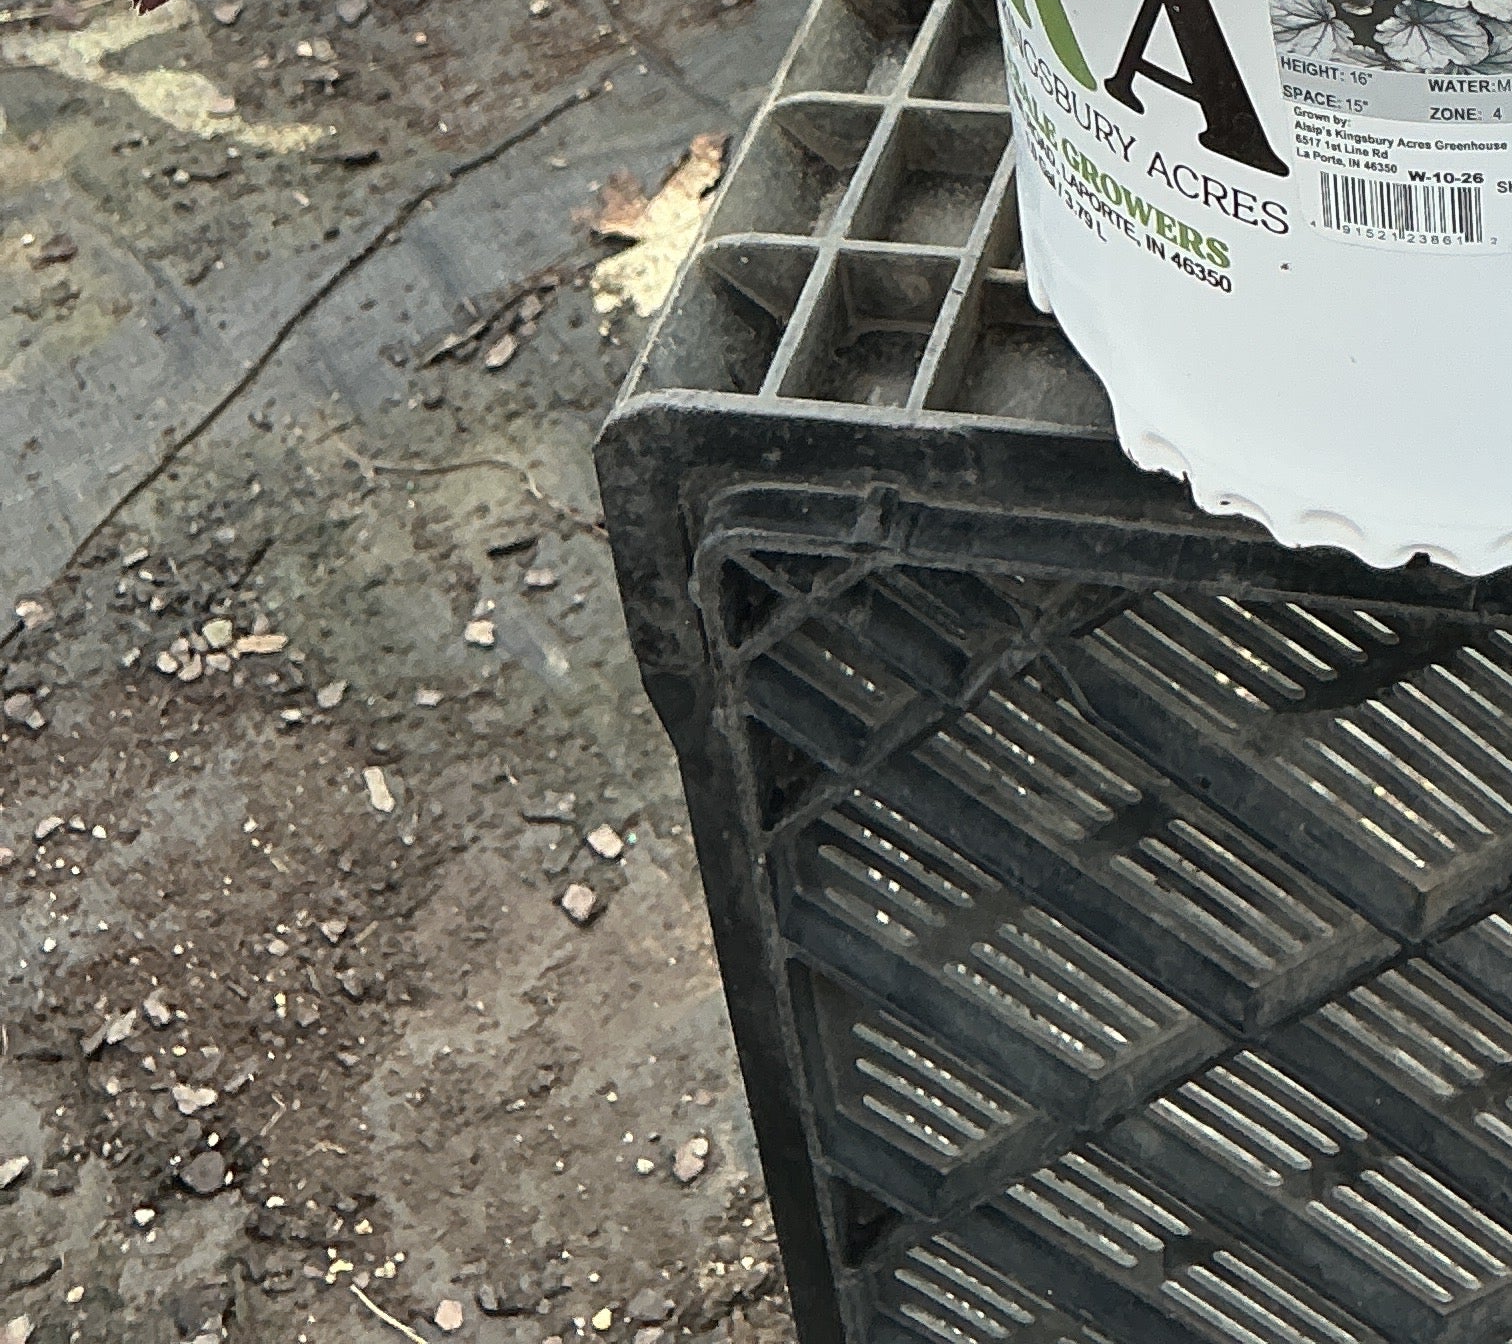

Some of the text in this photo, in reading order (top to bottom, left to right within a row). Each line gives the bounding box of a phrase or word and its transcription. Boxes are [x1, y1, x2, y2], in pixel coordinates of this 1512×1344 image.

[1280, 56, 1373, 87] HEIGHT: 16"
[1282, 84, 1369, 114] SPACE: 15"
[1293, 106, 1351, 129] Grown by:
[1430, 108, 1502, 121] ZONE: 4
[1294, 120, 1508, 151] Alsip's Kingsbury Acres Greenhouse
[1295, 134, 1389, 160] 6517 1st Line Rd
[1296, 148, 1311, 159] La
[1348, 158, 1361, 169] IN
[1364, 160, 1398, 174] 46350
[1408, 170, 1485, 184] W-10-26
[1061, 138, 1231, 269] GROWERS
[1147, 152, 1290, 235] ACRES
[1145, 233, 1166, 261] IN
[1170, 252, 1232, 293] 46350
